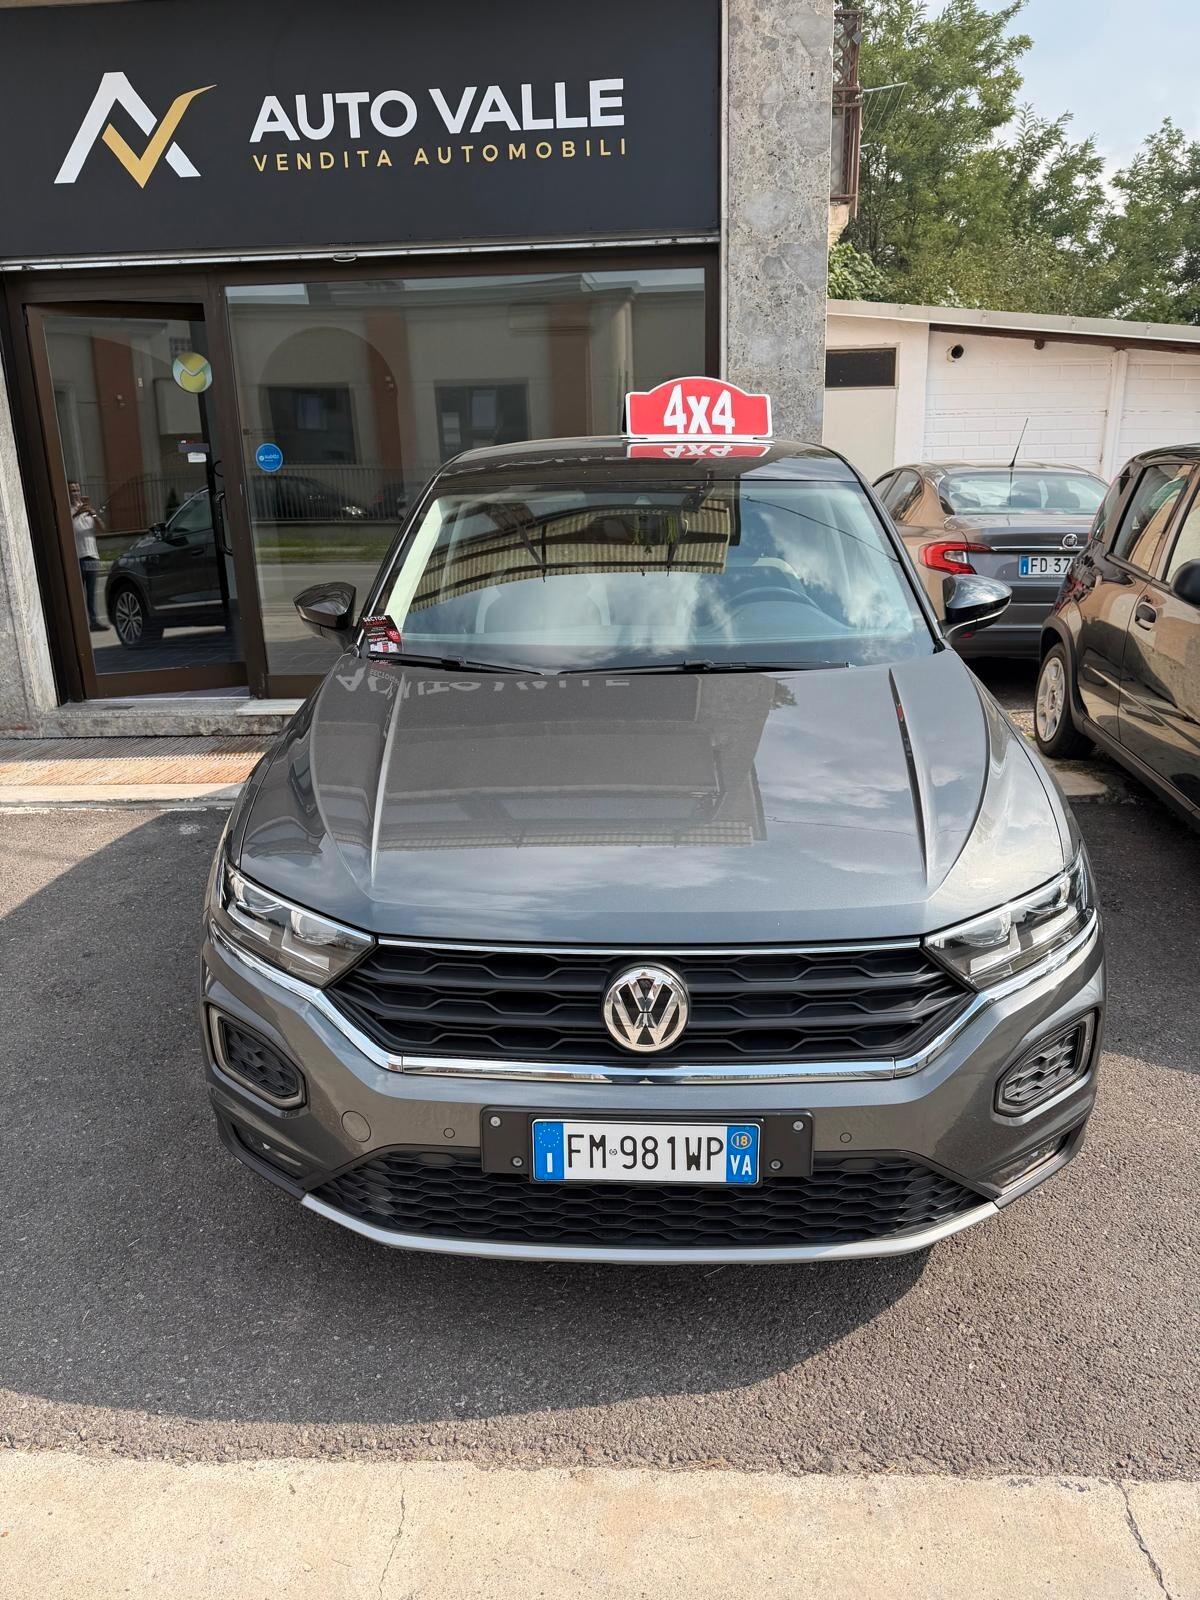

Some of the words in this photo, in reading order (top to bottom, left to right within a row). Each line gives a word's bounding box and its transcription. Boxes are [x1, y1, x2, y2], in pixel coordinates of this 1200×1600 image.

[249, 89, 418, 142] AUTO
[428, 78, 626, 134] VALLE
[253, 149, 392, 172] VENDITA
[414, 138, 627, 166] AUTOMOBILI
[663, 383, 736, 434] 4x4
[735, 1135, 748, 1148] 18
[730, 1154, 752, 1176] VA
